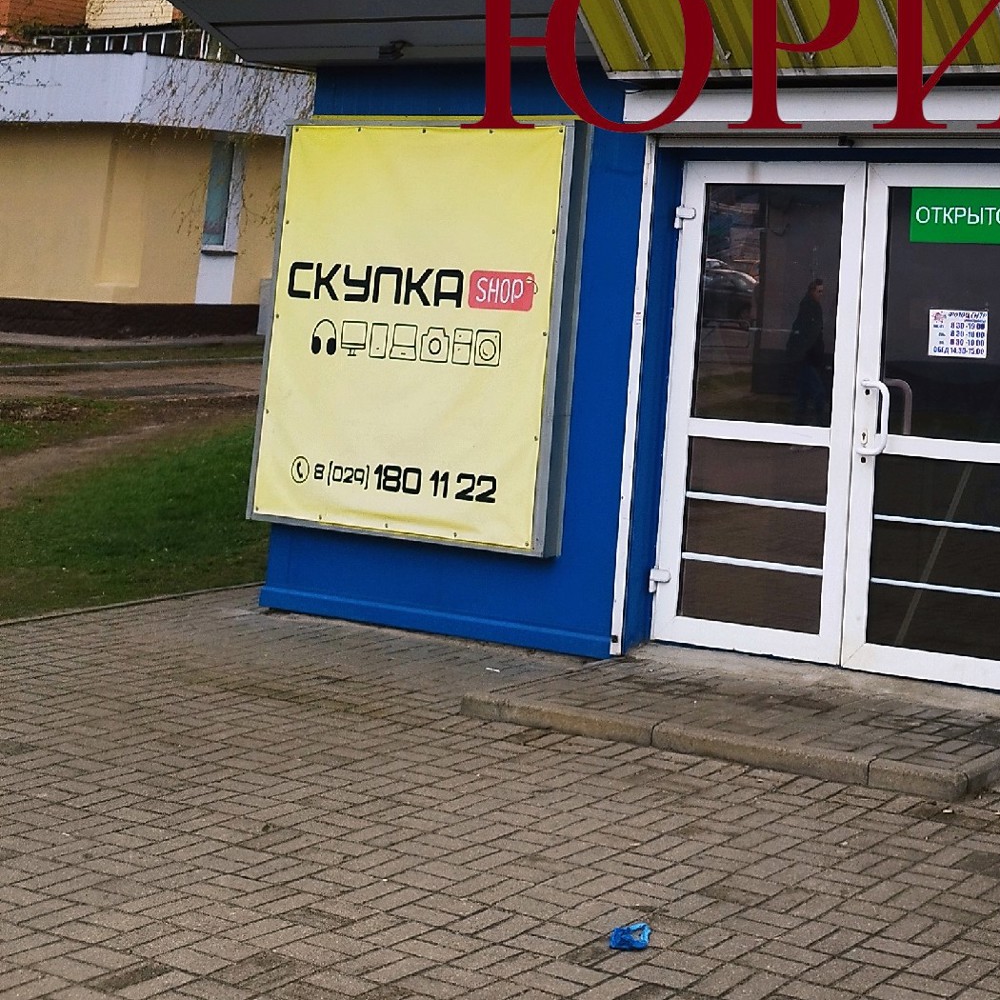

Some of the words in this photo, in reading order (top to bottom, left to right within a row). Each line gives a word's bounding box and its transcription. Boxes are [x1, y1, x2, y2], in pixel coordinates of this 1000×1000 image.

[288, 261, 464, 308] СКУПКА
[476, 277, 524, 304] SHOP
[314, 463, 325, 480] 8
[373, 463, 422, 495] 180
[429, 469, 450, 498] 11
[454, 472, 497, 504] 22
